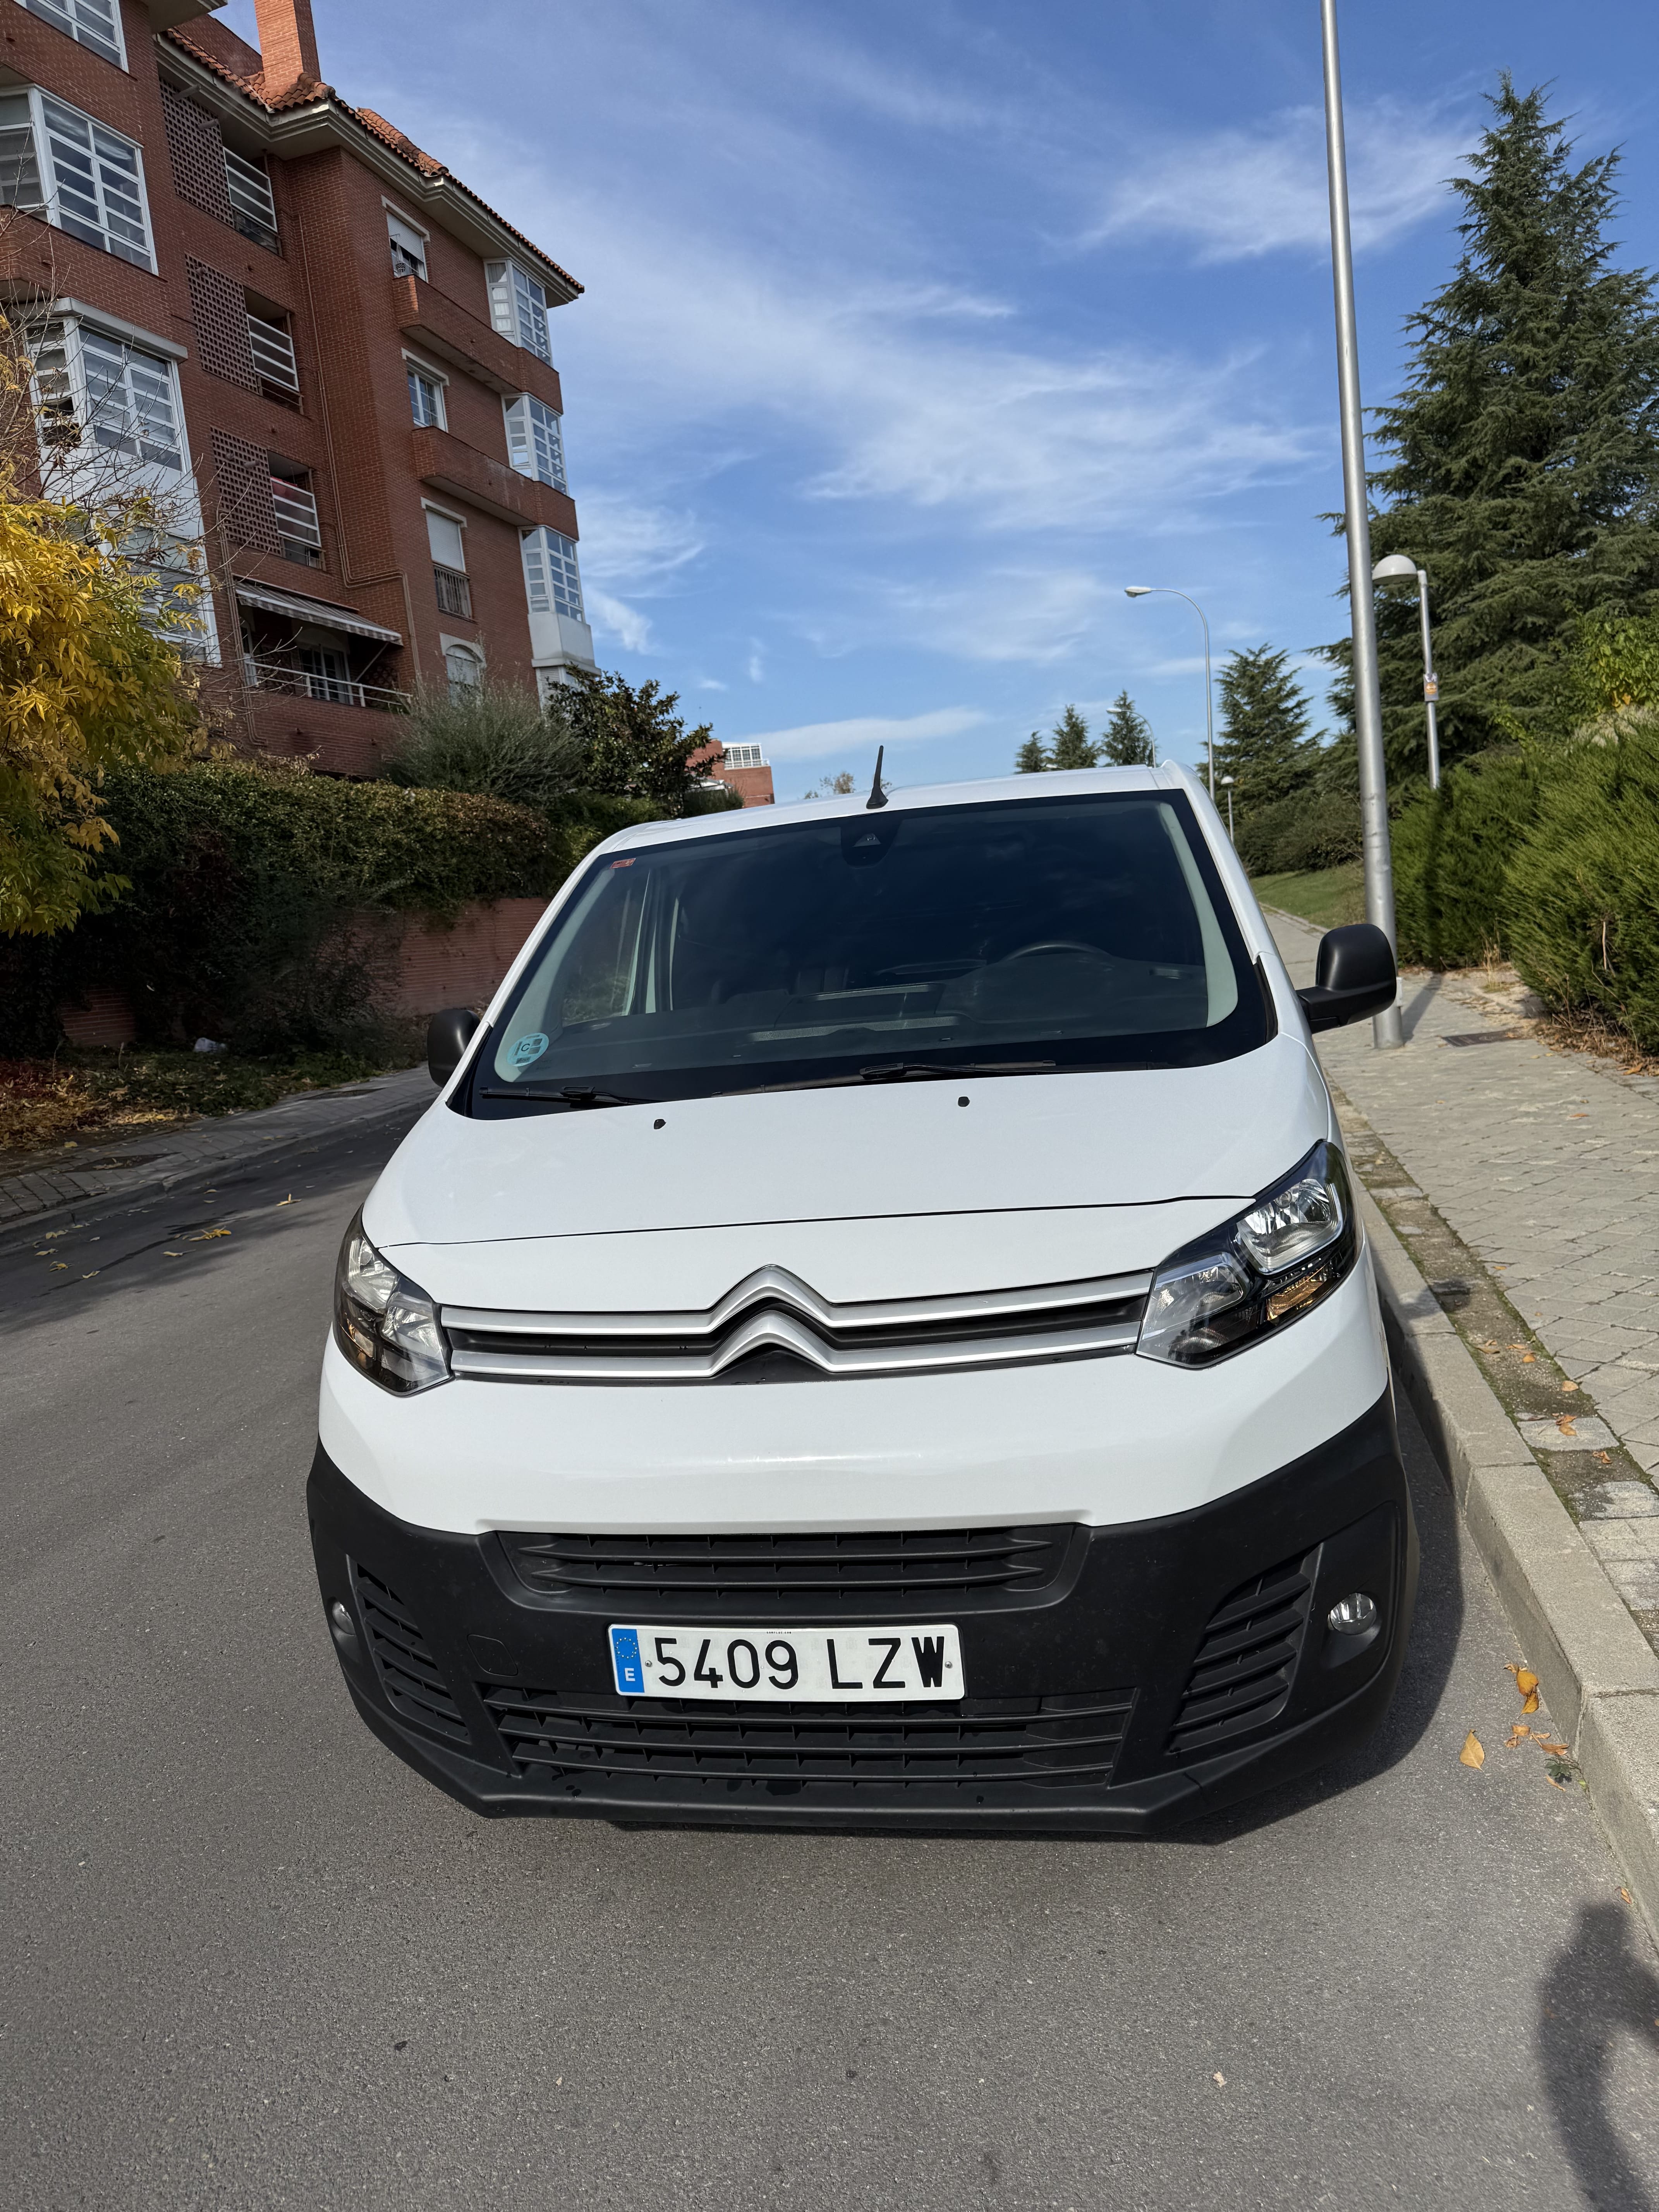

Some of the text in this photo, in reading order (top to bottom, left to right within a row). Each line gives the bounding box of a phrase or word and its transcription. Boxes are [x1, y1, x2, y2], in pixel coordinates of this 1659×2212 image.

[624, 1668, 636, 1681] E
[654, 1636, 945, 1690] 5409 LZW
